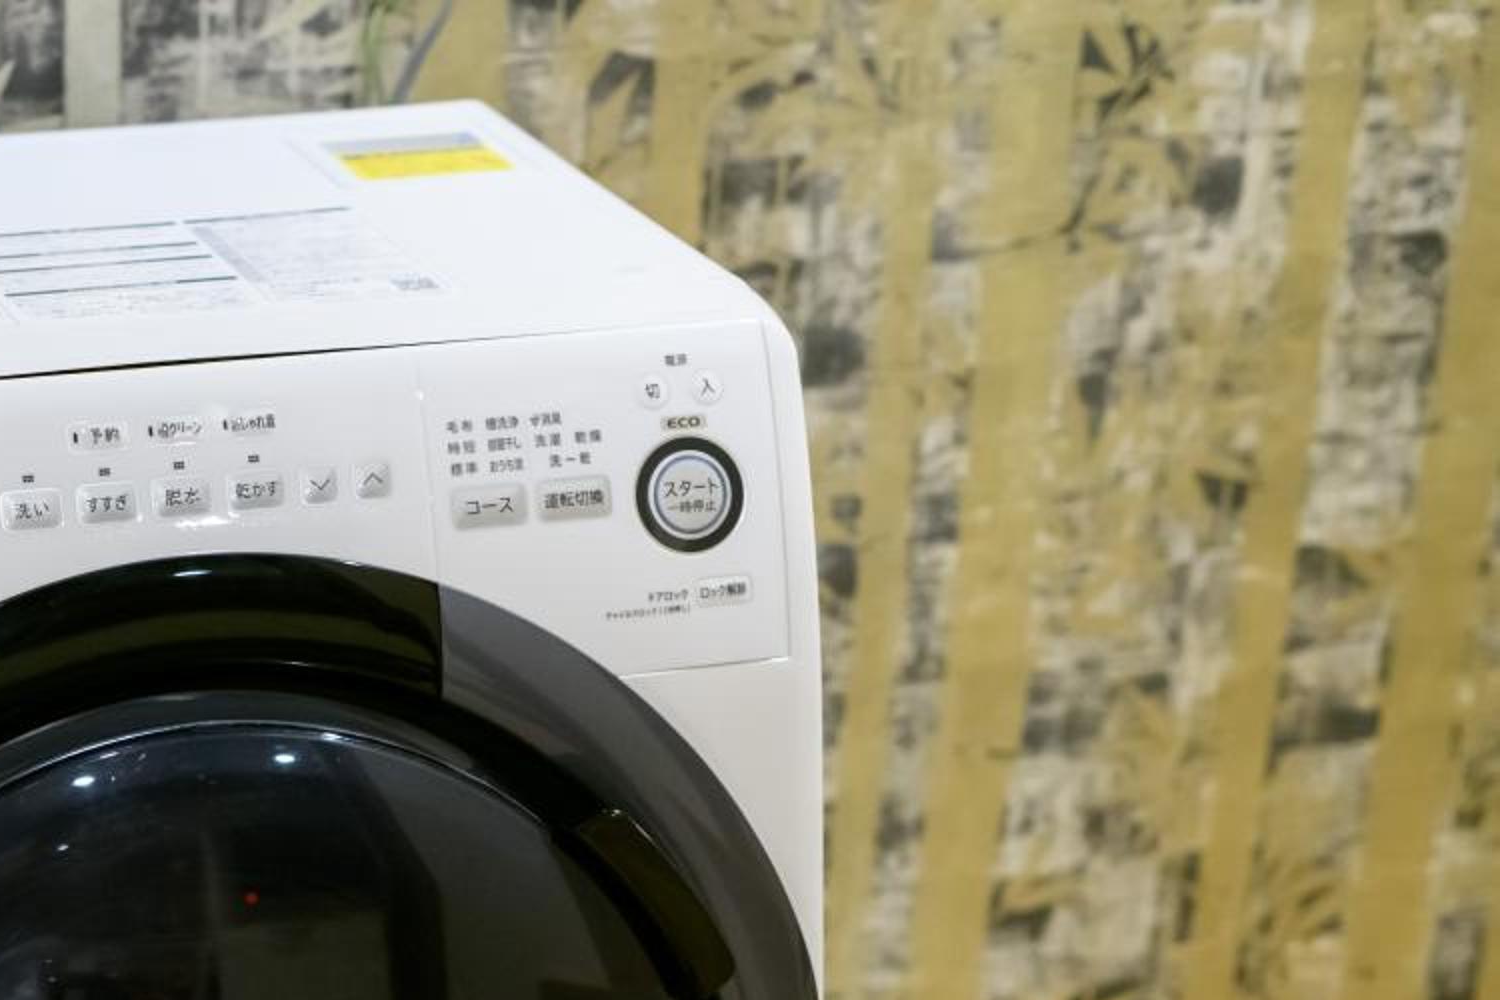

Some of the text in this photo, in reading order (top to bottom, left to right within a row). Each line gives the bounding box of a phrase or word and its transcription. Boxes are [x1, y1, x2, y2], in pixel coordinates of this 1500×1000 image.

[644, 383, 661, 400] 切
[700, 377, 717, 397] 入
[666, 415, 701, 430] ECO
[664, 476, 720, 497] スタート
[87, 493, 128, 513] すすぎ
[466, 496, 515, 516] コース
[545, 489, 604, 509] 運転切換
[15, 502, 51, 520] 洗い
